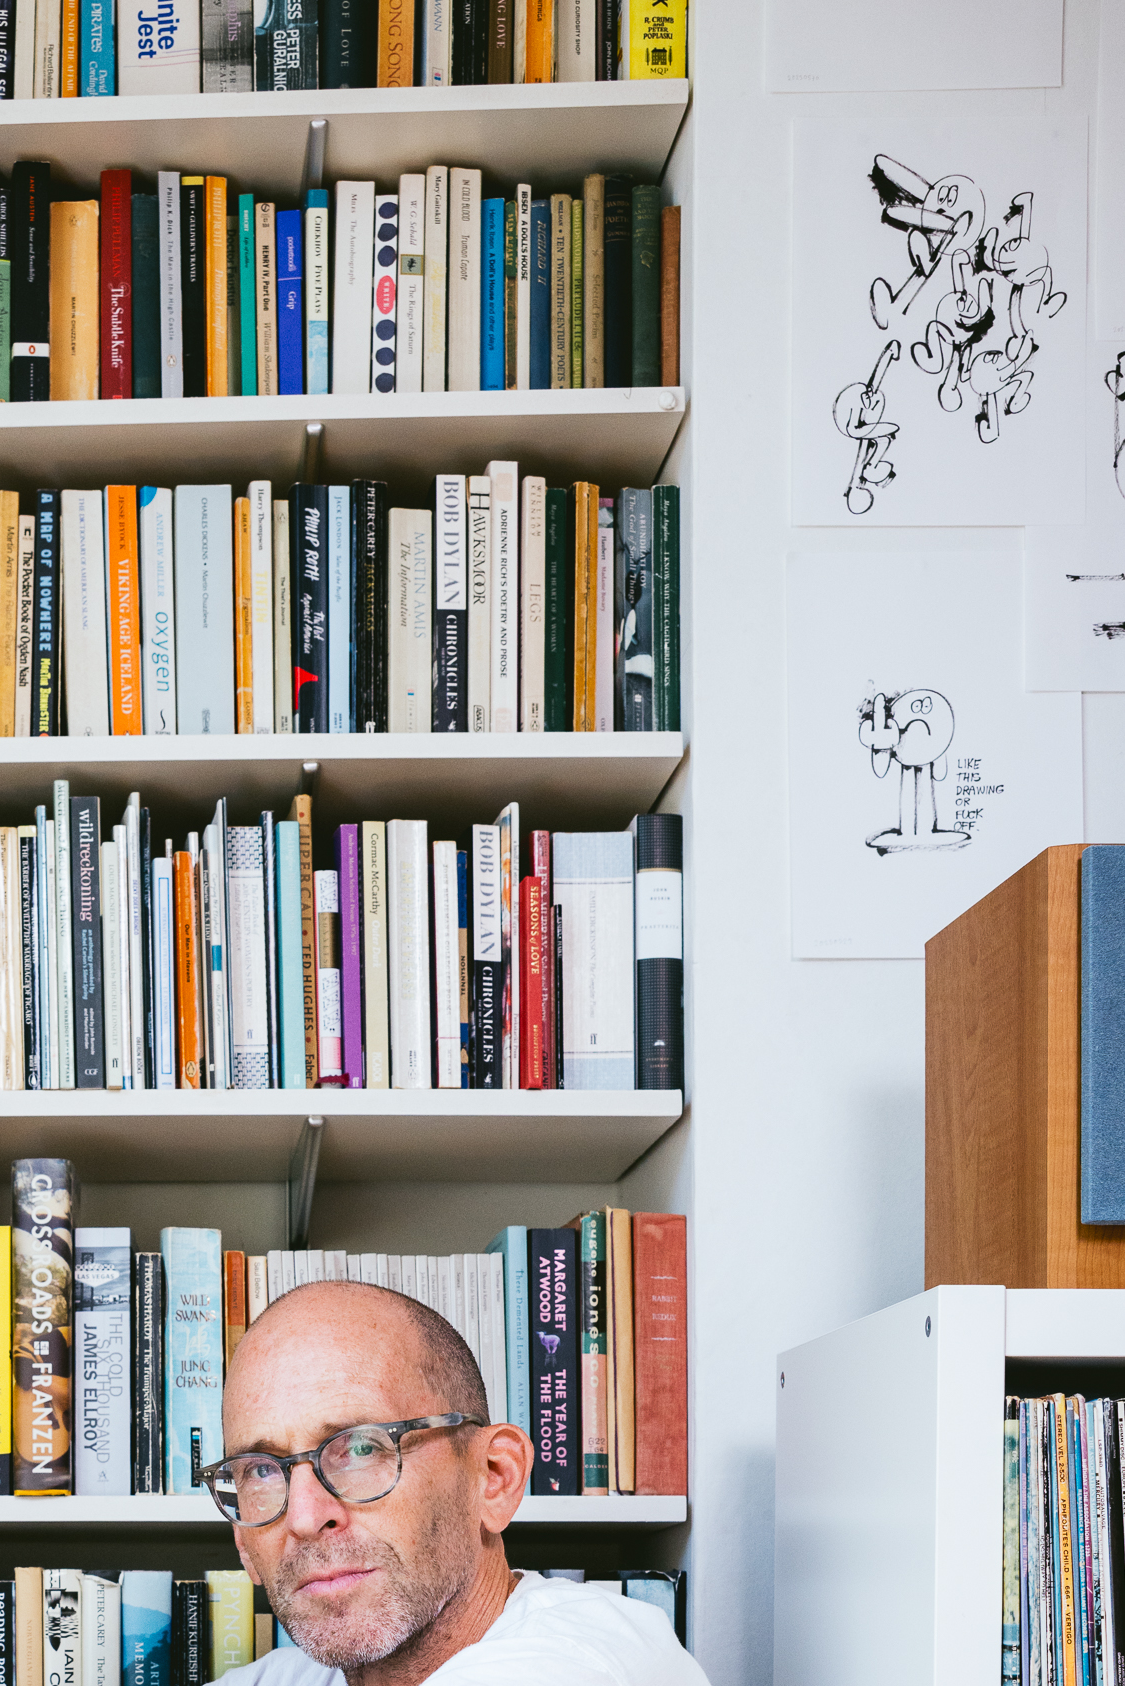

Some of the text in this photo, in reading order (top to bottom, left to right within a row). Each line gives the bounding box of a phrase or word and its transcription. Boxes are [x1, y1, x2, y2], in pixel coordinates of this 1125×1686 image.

[138, 10, 157, 59] Jest
[287, 29, 299, 69] PETER
[537, 220, 546, 286] RICHARD II
[286, 290, 297, 310] Grip
[557, 236, 566, 382] TEN TWENTIETH-CENTURY POETS
[39, 493, 53, 651] A MAP OF NOWHERE
[443, 481, 460, 605] BOB DYLAN
[18, 551, 33, 687] The Pocket Book of Ogden Nash
[118, 558, 133, 714] VIKING AGE ICELAND
[152, 611, 171, 693] oxygen
[446, 614, 458, 710] CHRONICLES
[955, 797, 971, 806] OR
[956, 772, 981, 782] THIS
[956, 784, 1005, 795] DRAWING
[957, 758, 982, 769] LIKE
[955, 808, 984, 820] FUCK
[78, 808, 94, 922] wildreckoning
[368, 833, 380, 915] Cormac McCarthy
[302, 944, 314, 1031] TED HUGHES
[481, 966, 494, 1062] CHRONICLES
[31, 1173, 53, 1474] CROSSROADS FRANZEN
[540, 1256, 551, 1323] ATWOOD
[554, 1249, 566, 1331] MARGARET
[84, 1324, 97, 1452] JAMES ELLROY
[540, 1373, 551, 1463] THE FLOOD
[555, 1369, 566, 1466] THE YEAR OF
